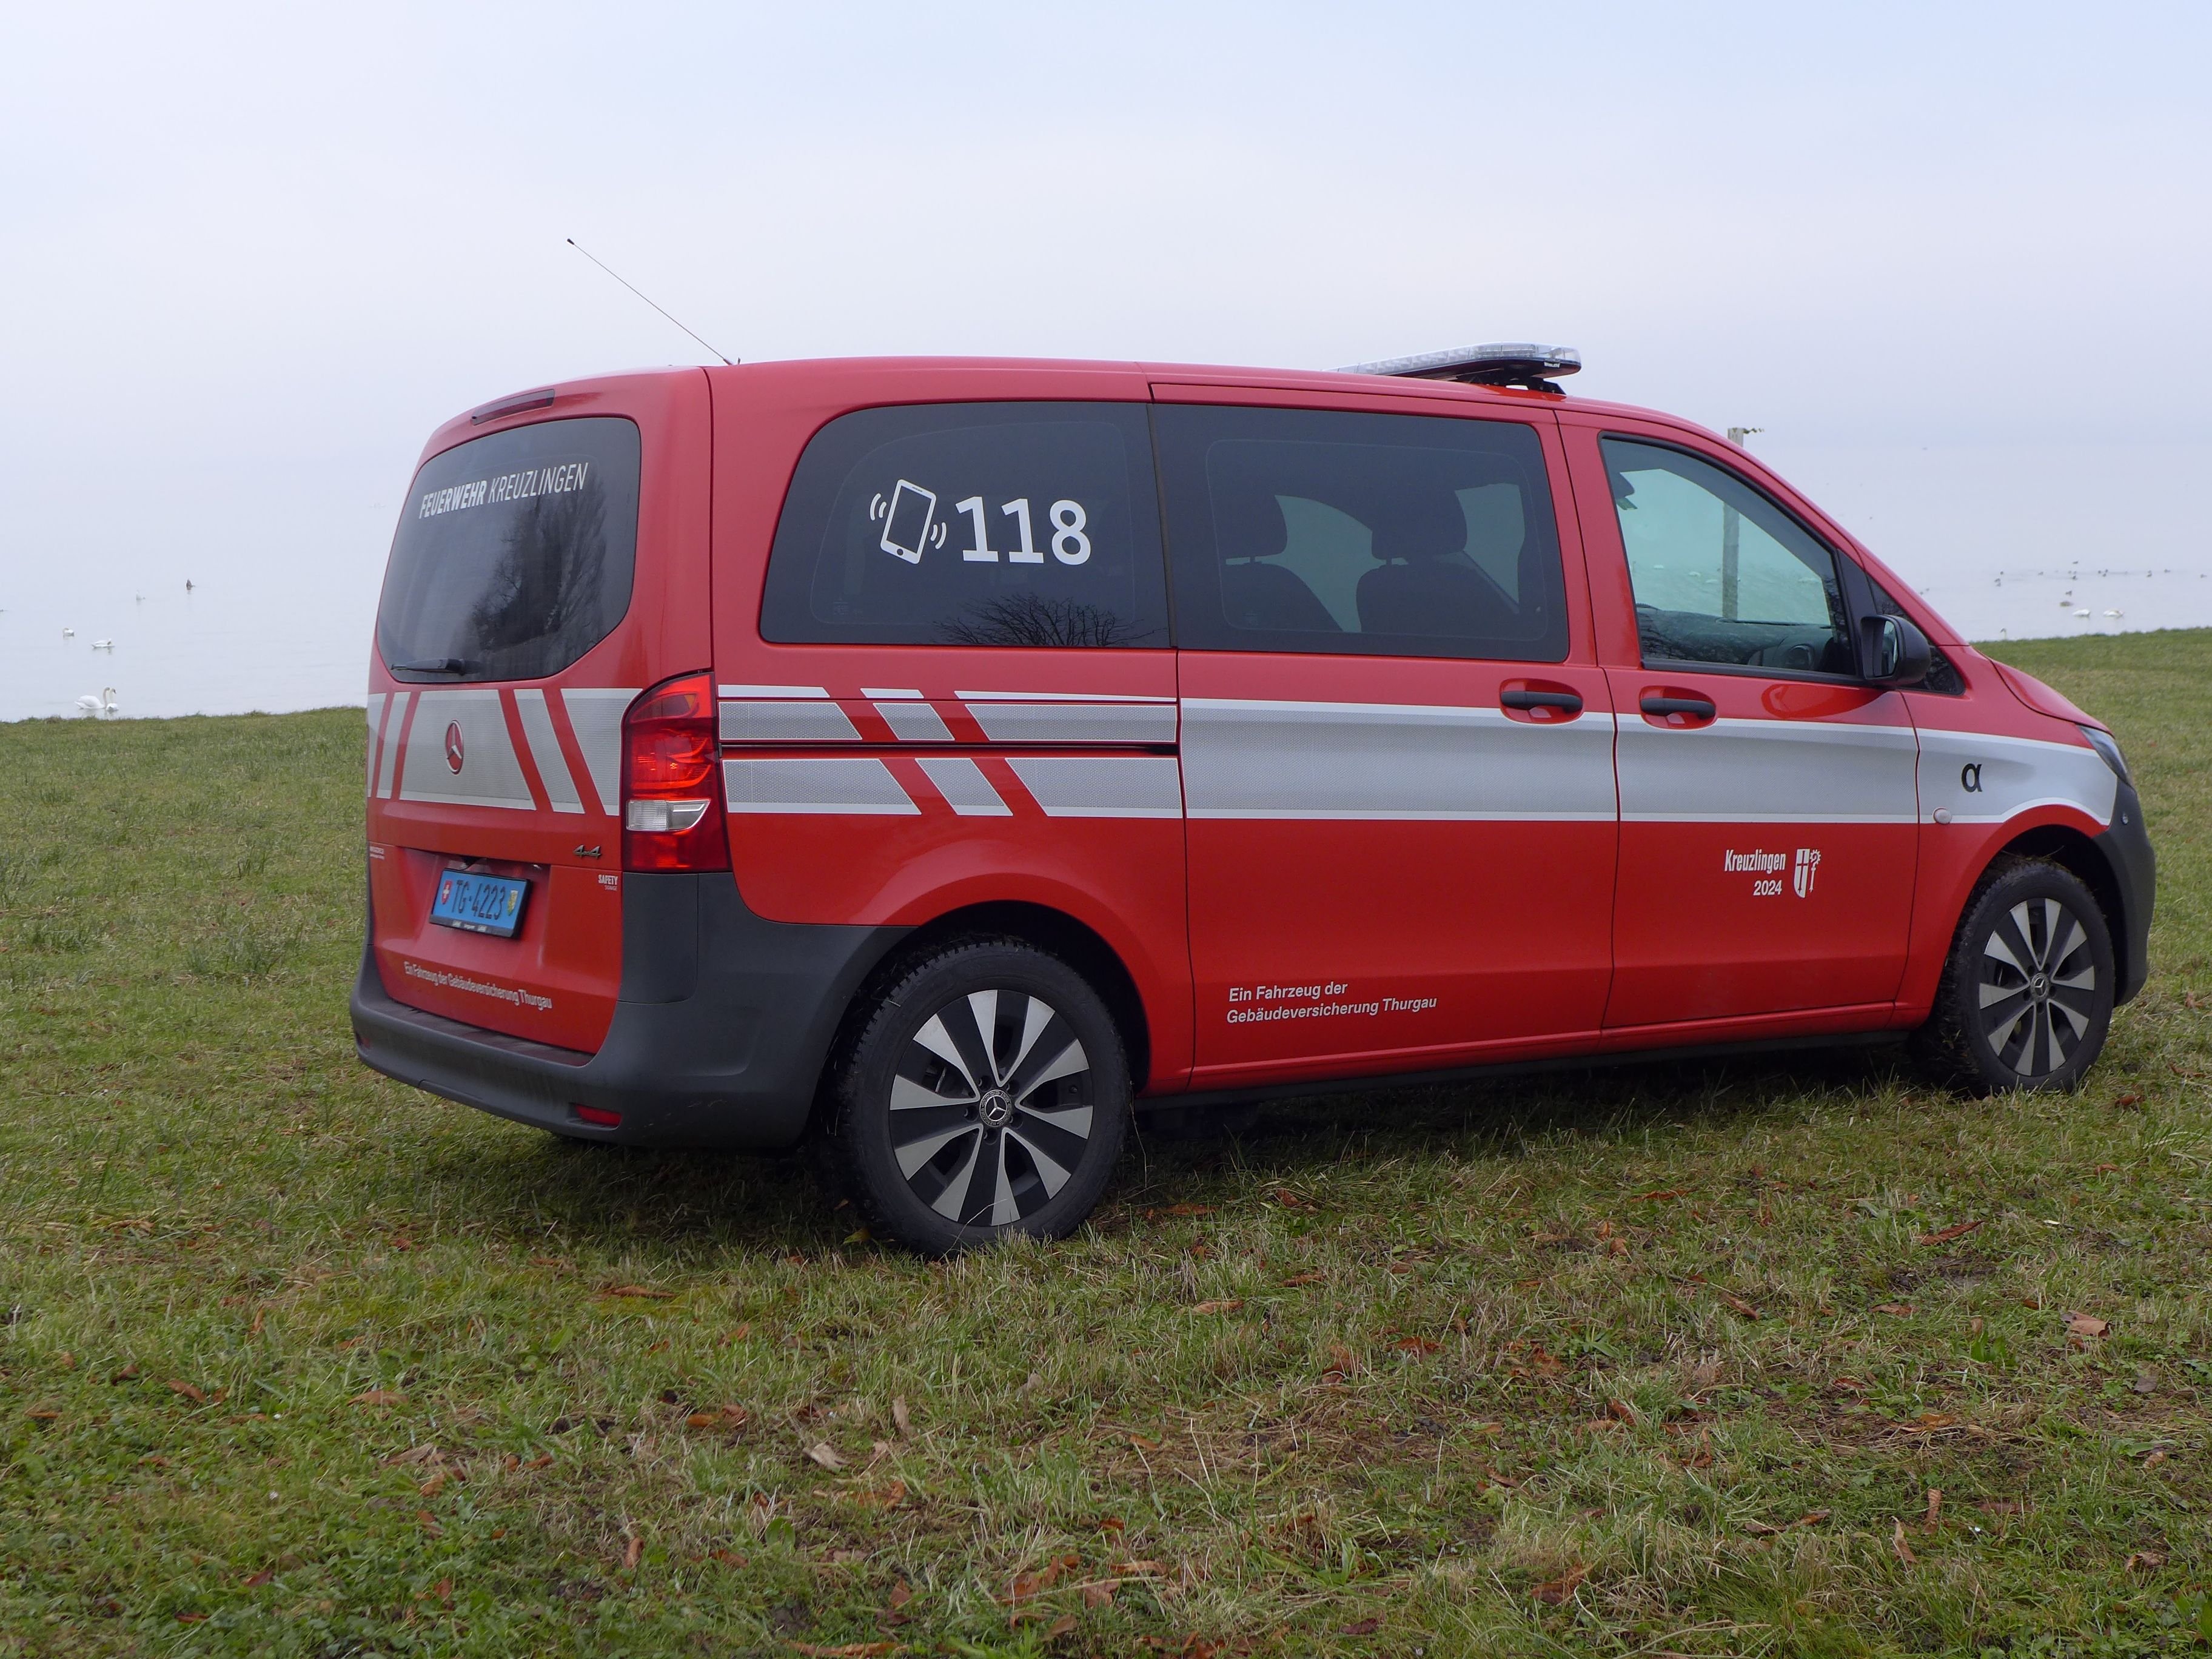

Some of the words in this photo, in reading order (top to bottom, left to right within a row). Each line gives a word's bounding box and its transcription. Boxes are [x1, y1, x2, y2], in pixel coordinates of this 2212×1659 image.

[419, 480, 487, 519] FEUERWEHR
[488, 463, 589, 503] KREUZLINGEN
[955, 496, 1091, 565] 118
[1724, 849, 1786, 874] Kreuzlingen
[598, 874, 618, 885] SAFETY
[1753, 880, 1783, 896] 2024
[404, 961, 414, 974] Ein
[412, 964, 438, 986] Fahrzeug
[438, 971, 450, 985] der
[518, 989, 553, 1011] Thurgau
[1229, 987, 1252, 1002] Ein
[1256, 984, 1321, 1000] Fahrzeug
[1324, 981, 1348, 995] der
[1227, 1001, 1379, 1024] Gebäudeversicherung
[1382, 997, 1437, 1012] Thurgau
